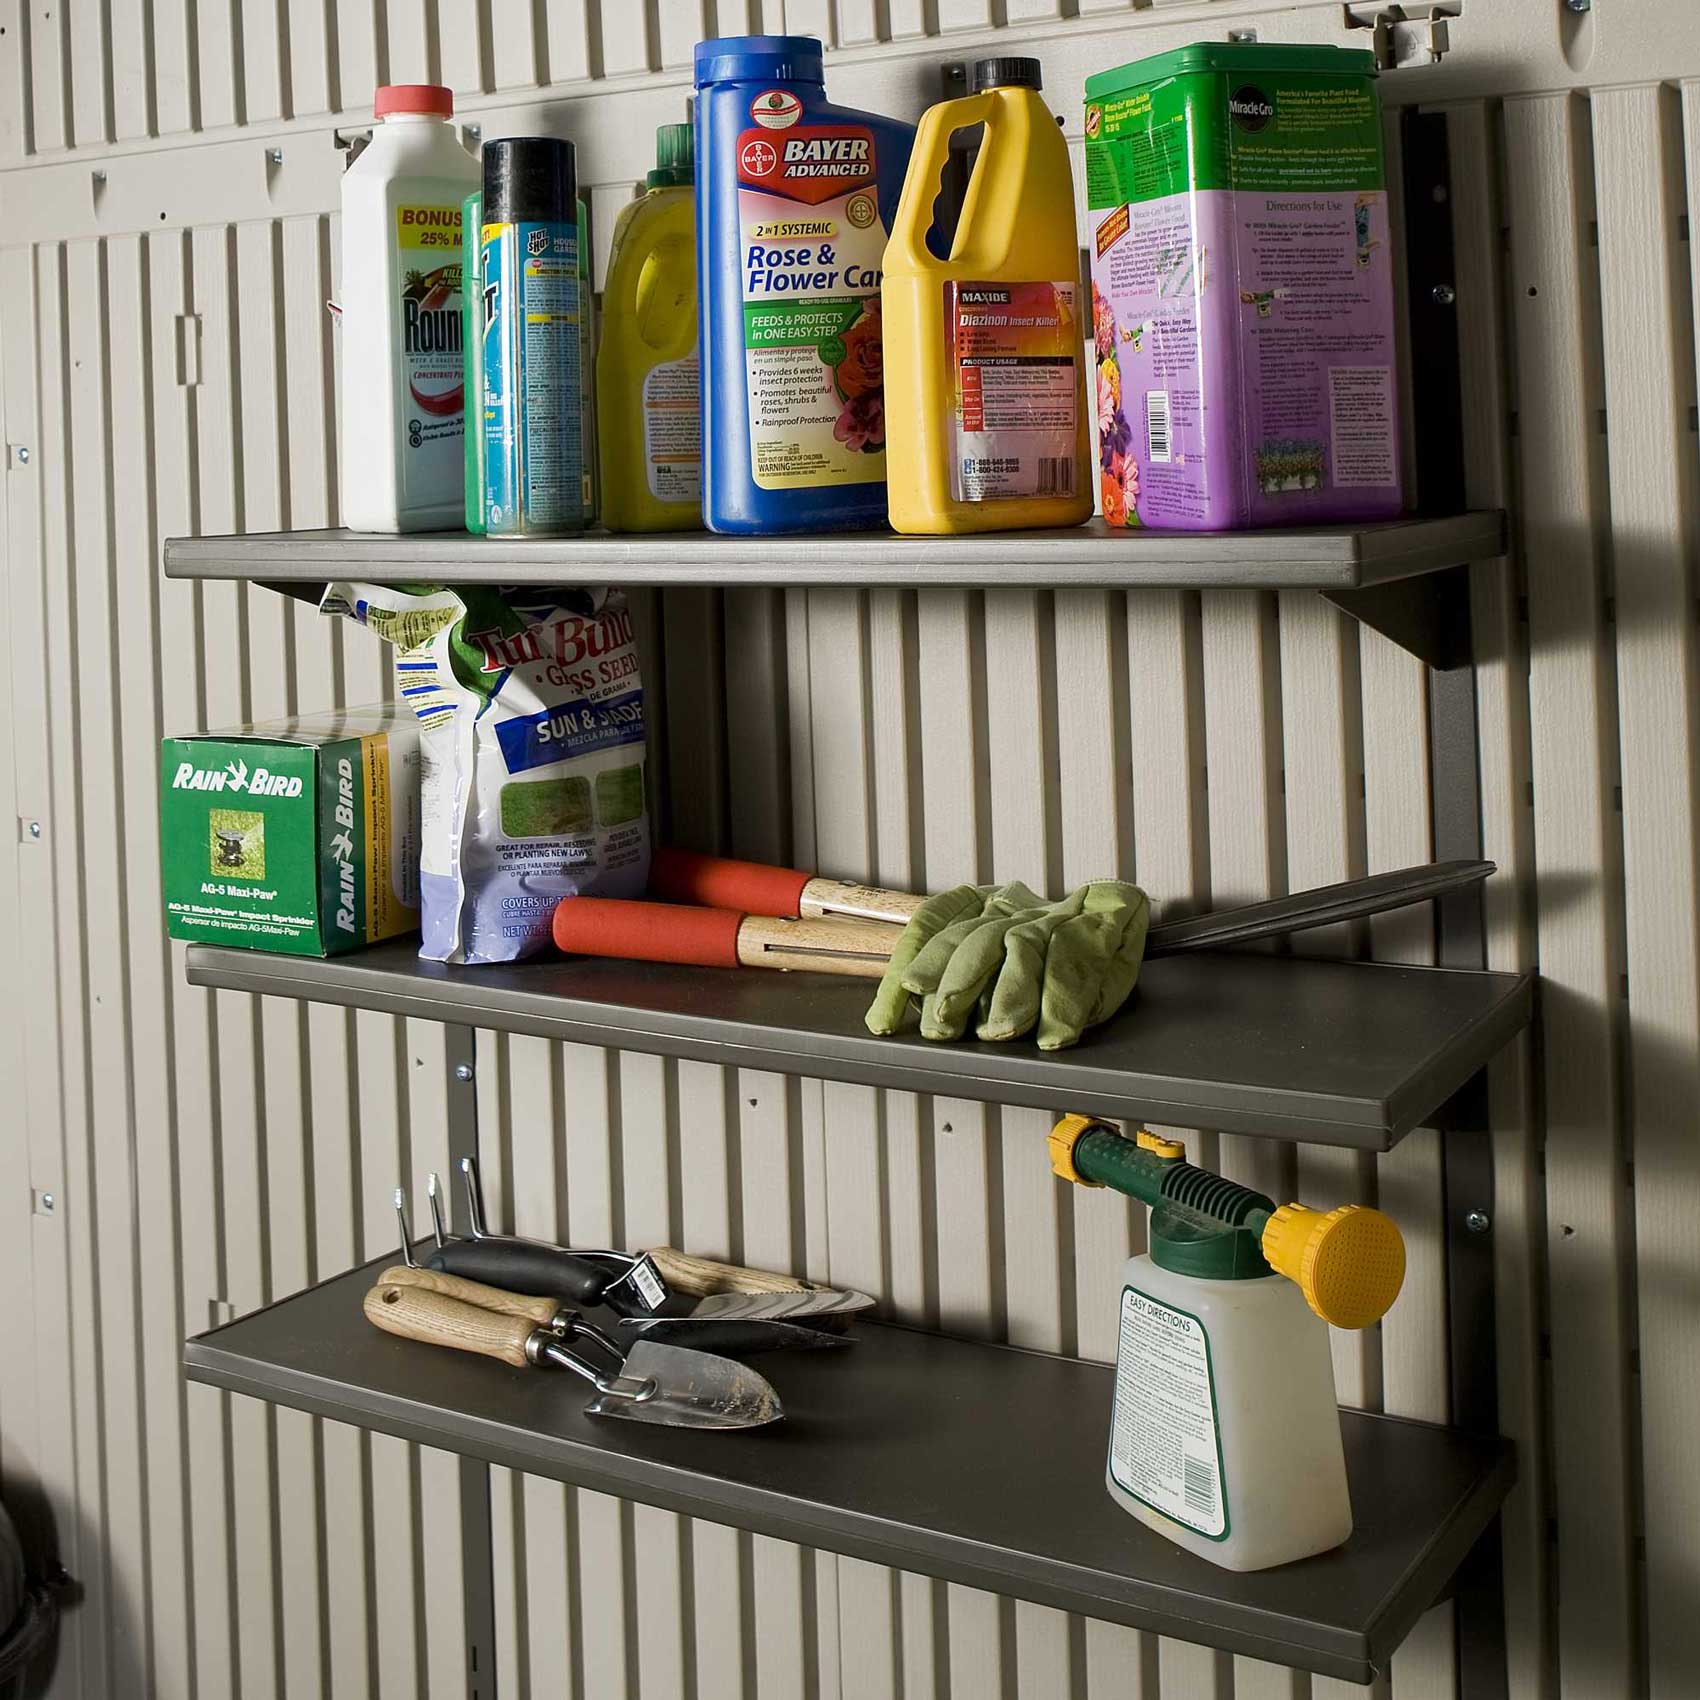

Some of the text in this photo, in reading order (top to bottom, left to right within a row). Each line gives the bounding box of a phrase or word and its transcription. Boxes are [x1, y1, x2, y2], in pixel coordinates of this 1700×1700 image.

[784, 139, 870, 163] BAYER
[784, 163, 871, 178] ADVANCED
[1266, 200, 1344, 211] Directions for Use
[403, 210, 463, 227] BONUS
[530, 230, 547, 242] HOT
[756, 226, 764, 236] 2
[774, 225, 780, 236] 1
[781, 223, 832, 235] SYSTEMIC
[421, 232, 450, 246] 25%
[528, 238, 550, 253] SHOT
[747, 244, 836, 269] Rose &
[749, 265, 882, 292] Flower Car
[962, 292, 1009, 305] MAXIDE
[403, 298, 464, 354] Roun
[752, 313, 843, 327] FEEDS & PROTECTS
[960, 314, 1059, 327] Diazinon Insect Killer
[753, 326, 838, 340] in ONE EASY STEP
[774, 355, 796, 364] simple
[797, 356, 814, 364] paso
[759, 366, 823, 377] Provides 6 weeks
[760, 375, 824, 386] insect protection
[760, 386, 832, 397] Promotes beautiful
[761, 399, 784, 407] roses,
[784, 397, 810, 405] shrubs
[761, 406, 790, 415] flowers
[762, 415, 837, 428] Rainproof Protection
[759, 462, 791, 473] WARNING
[466, 627, 542, 672] Tur
[599, 654, 638, 685] SEED
[590, 691, 602, 702] DE
[537, 712, 579, 744] SUN
[581, 709, 596, 731] &
[599, 701, 643, 728] SADE
[567, 732, 599, 748] MEZCLA
[172, 762, 303, 798] RAIN BIRD
[335, 758, 355, 933] RAIN BIRD
[496, 844, 518, 852] GREAT
[502, 847, 593, 860] OR PLANTING NEW LAWNS
[527, 860, 542, 869] PARA
[201, 882, 226, 896] AG-5
[502, 896, 555, 909] COVERS UP
[168, 902, 191, 912] AG-5
[239, 910, 271, 922] Impact
[271, 914, 316, 927] Sprinkler
[502, 910, 521, 918] CUBRE
[181, 916, 210, 927] Aspersor
[210, 918, 220, 928] de
[220, 919, 248, 932] impacto
[502, 925, 521, 938] NET
[1130, 1295, 1191, 1332] EASY DIRECTIONS
